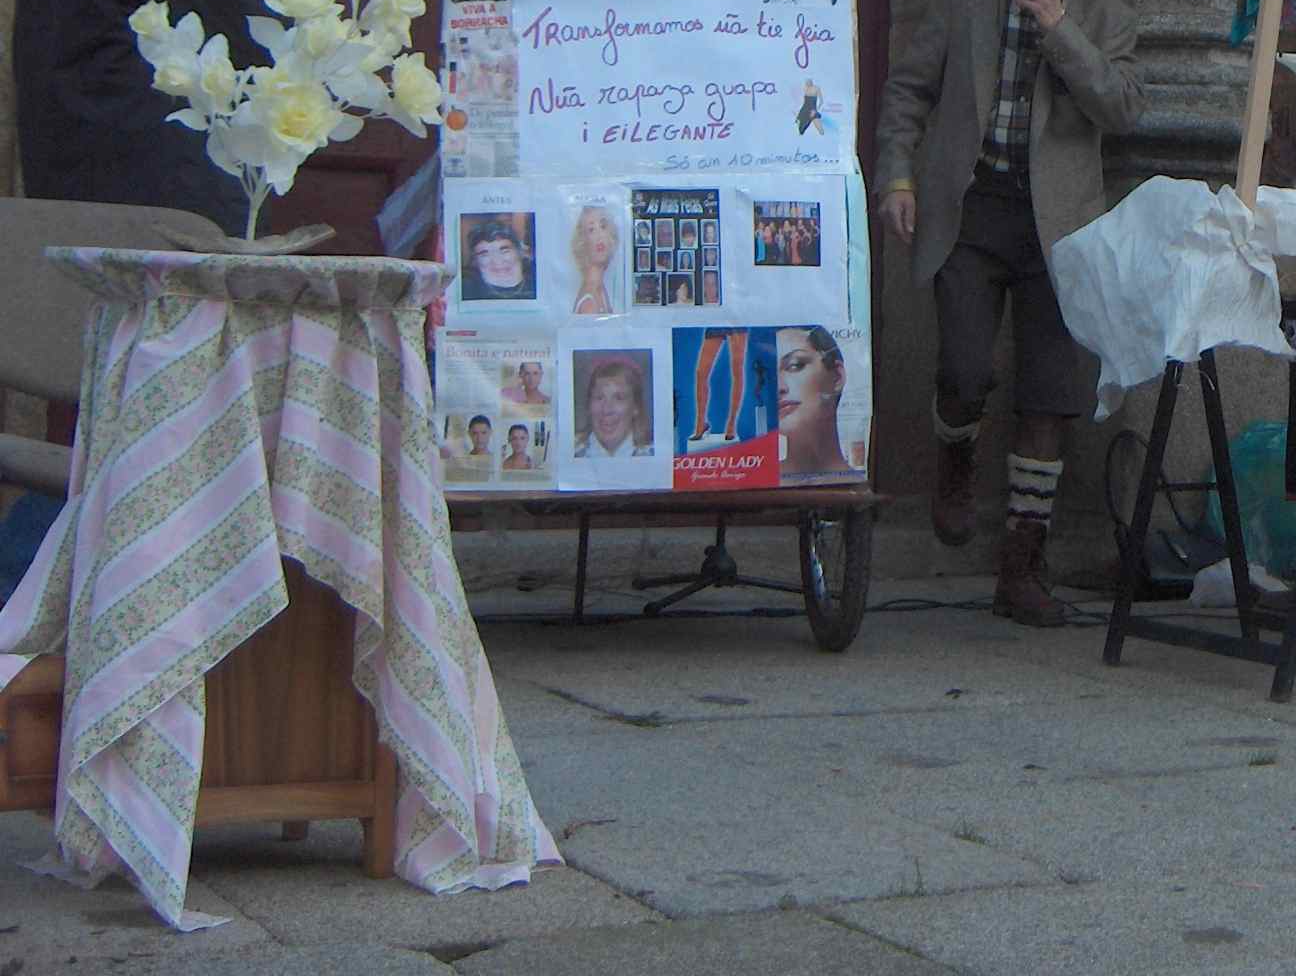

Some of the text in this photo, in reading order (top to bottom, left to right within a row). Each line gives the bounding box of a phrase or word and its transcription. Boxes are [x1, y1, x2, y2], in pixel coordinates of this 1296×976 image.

[794, 13, 836, 69] feia
[704, 81, 778, 122] guapa
[727, 152, 753, 167] 10
[673, 455, 766, 471] GOLDEN LADY
